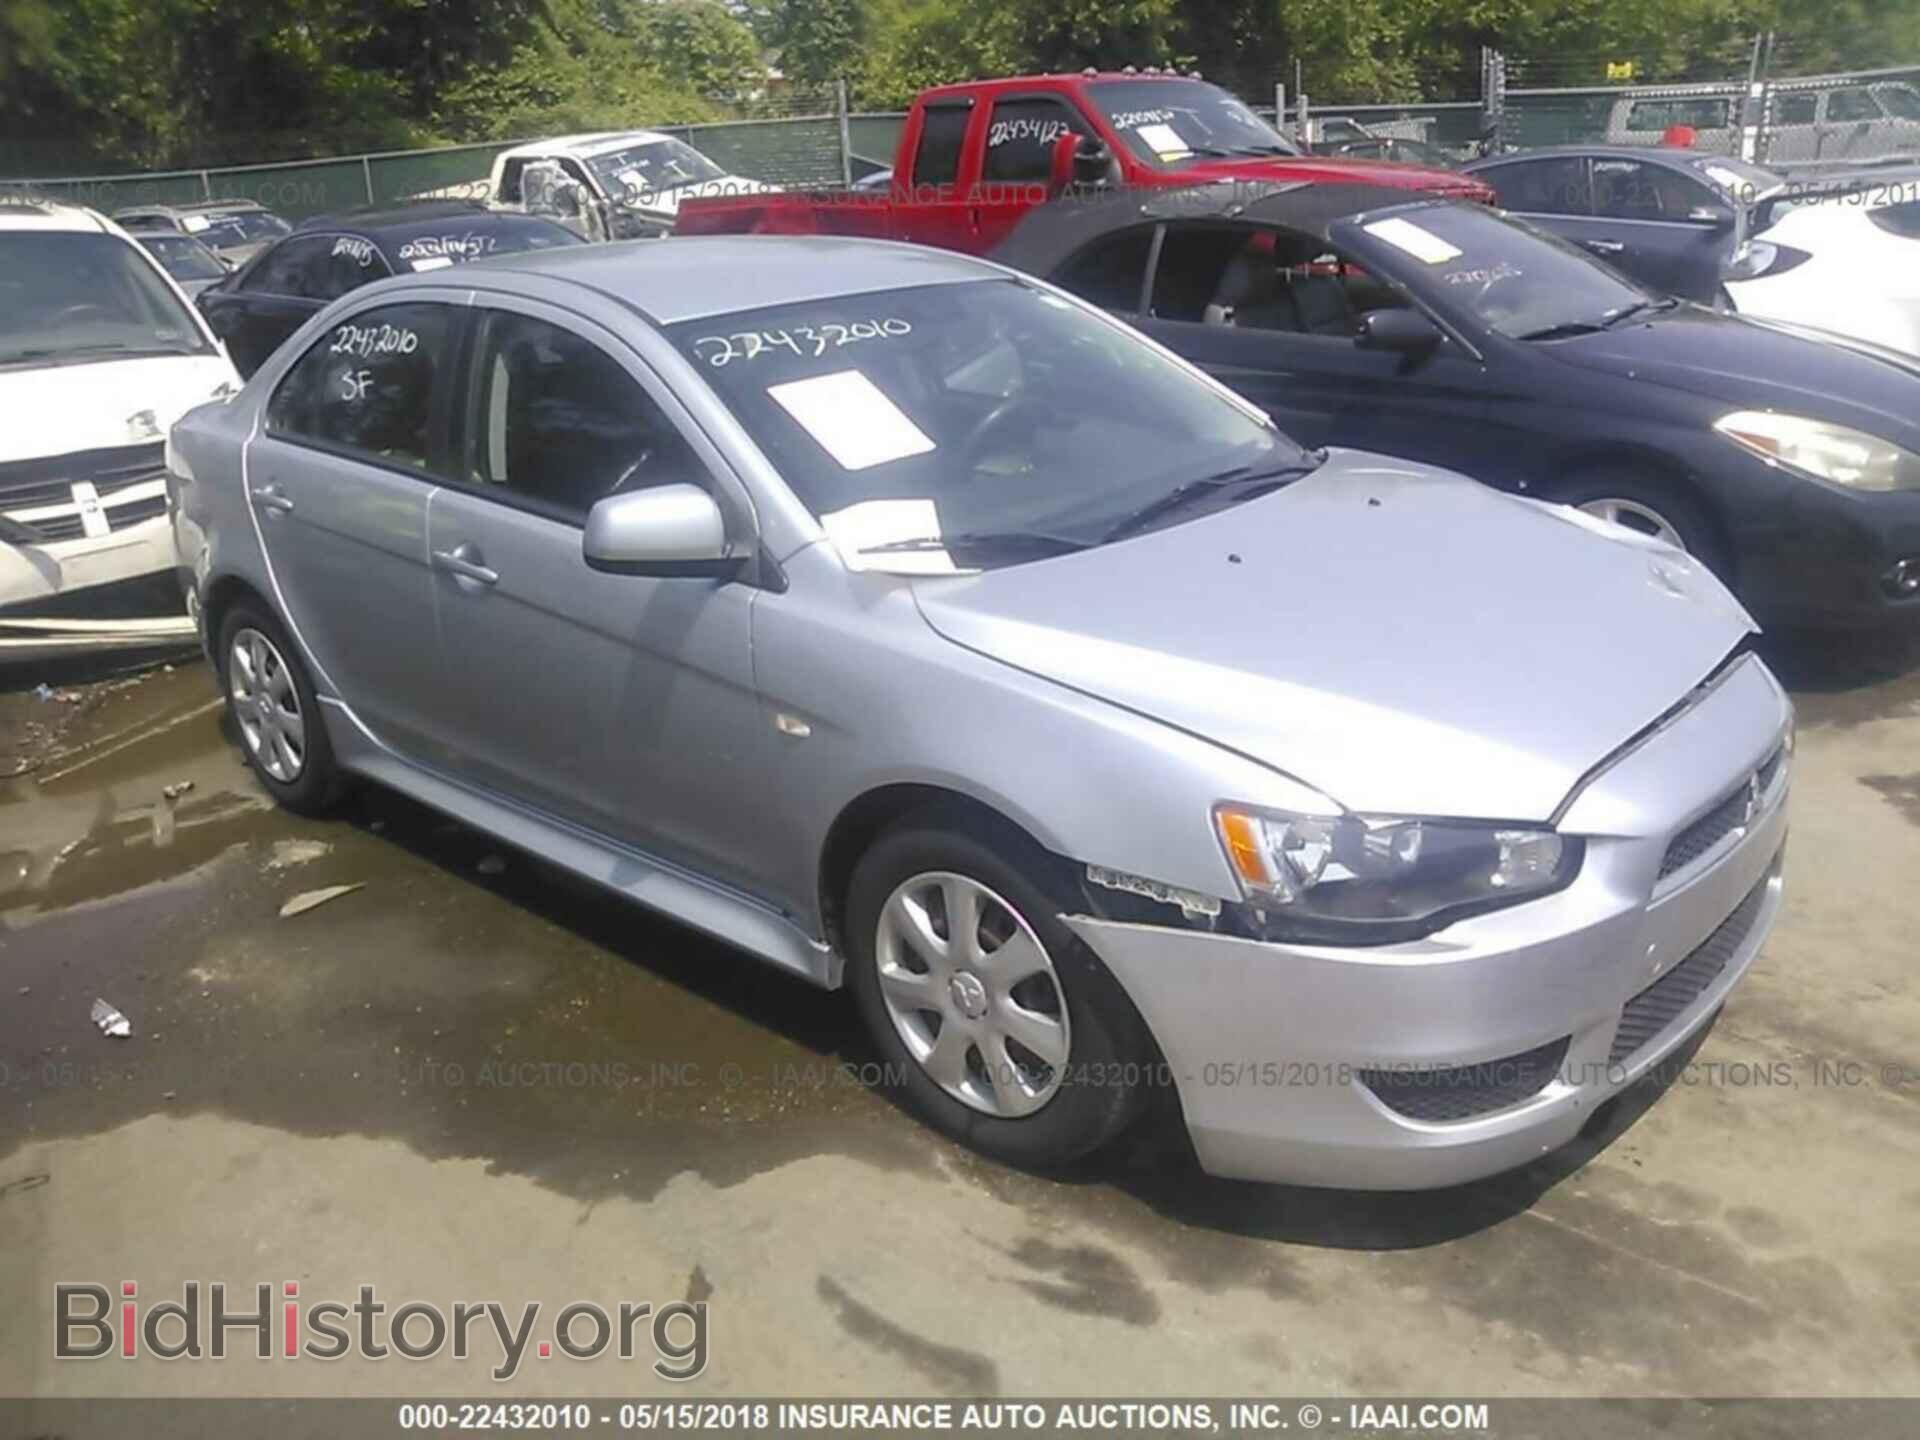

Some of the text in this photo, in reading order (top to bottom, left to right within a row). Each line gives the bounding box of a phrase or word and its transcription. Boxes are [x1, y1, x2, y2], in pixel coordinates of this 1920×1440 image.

[329, 325, 419, 358] 22432010
[695, 319, 912, 367] 22432010
[342, 370, 374, 401] SF
